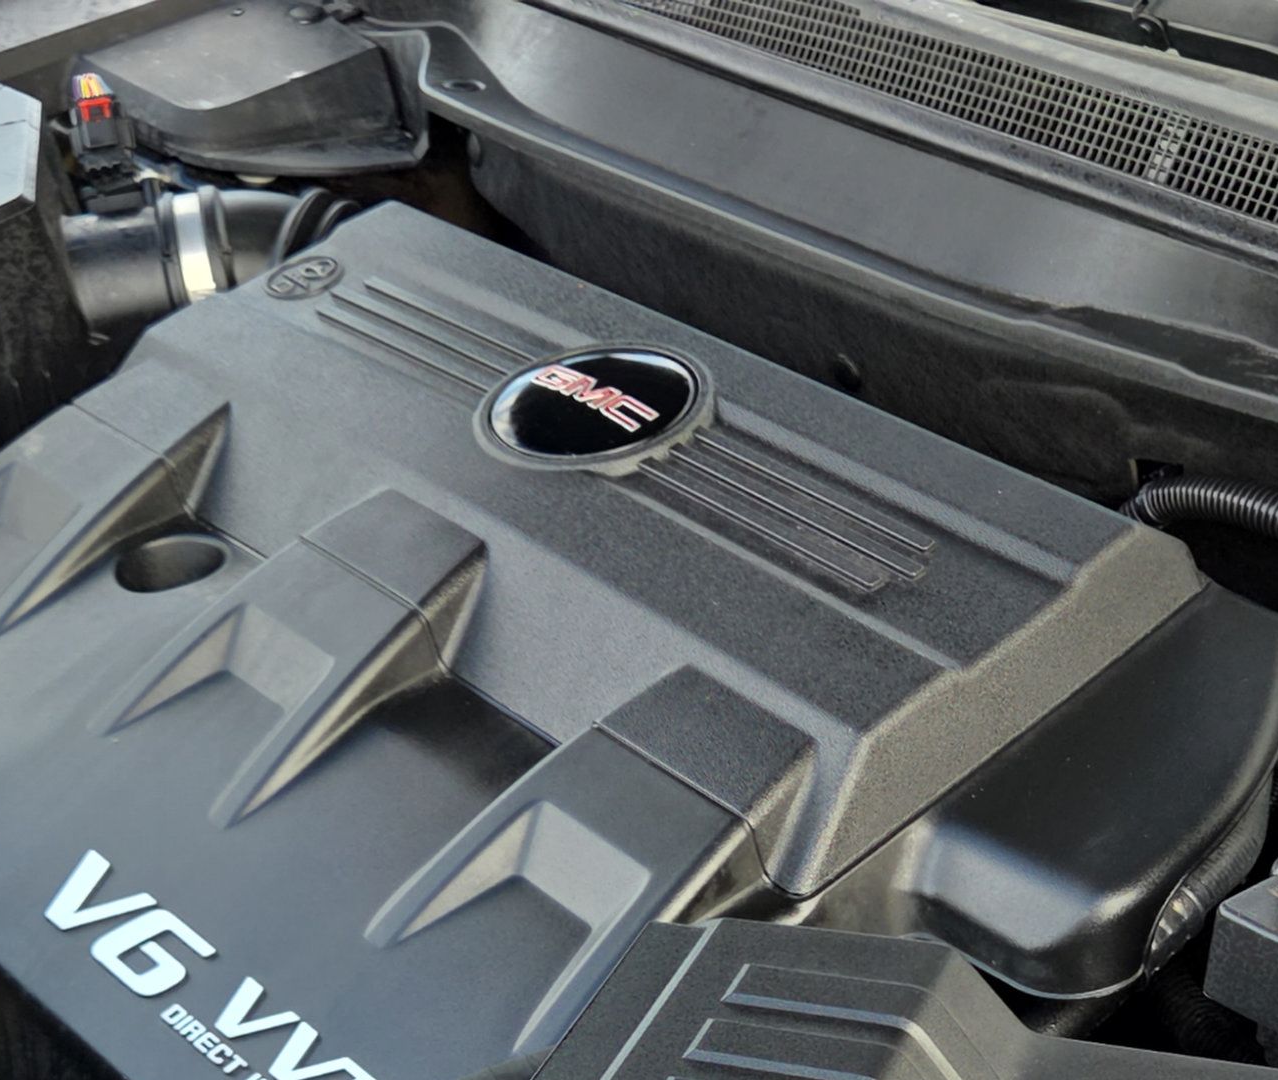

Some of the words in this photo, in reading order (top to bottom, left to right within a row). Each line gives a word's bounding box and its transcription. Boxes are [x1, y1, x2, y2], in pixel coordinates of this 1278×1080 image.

[531, 364, 660, 433] GMC
[44, 848, 217, 997] V6
[159, 1003, 248, 1074] DIRECT
